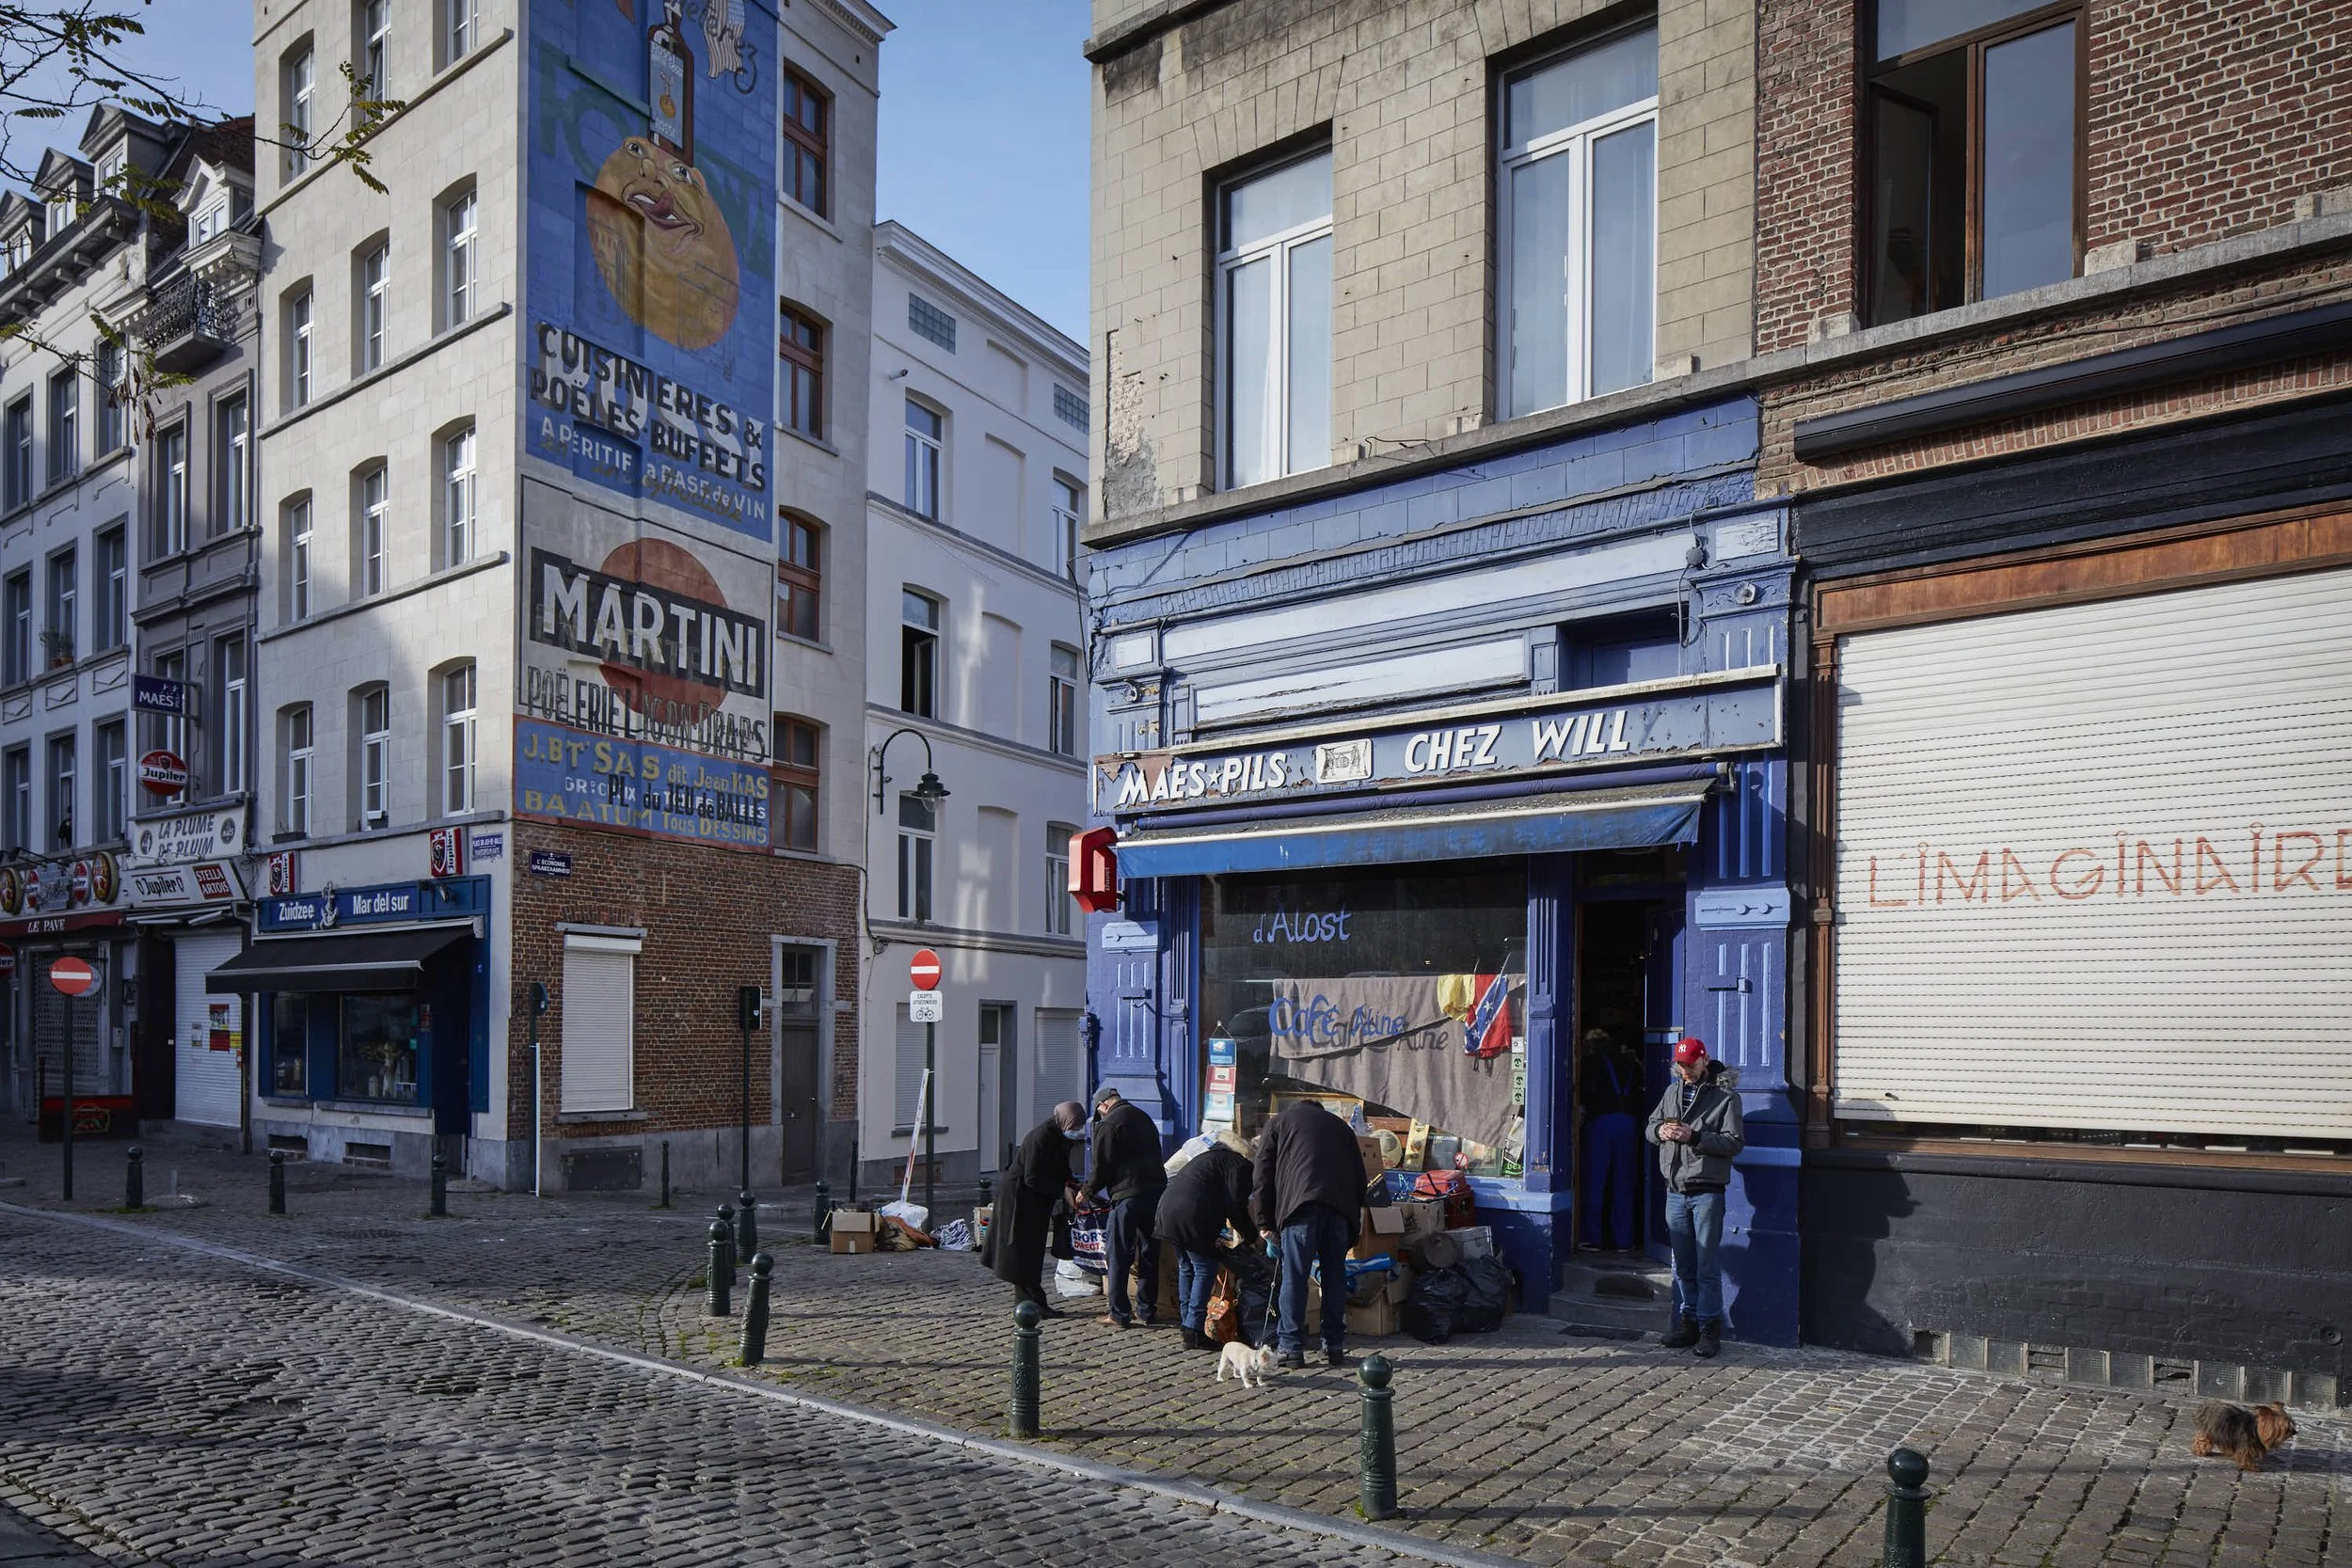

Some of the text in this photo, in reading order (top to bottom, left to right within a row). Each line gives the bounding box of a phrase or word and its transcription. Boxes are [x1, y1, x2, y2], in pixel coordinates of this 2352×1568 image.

[650, 420, 766, 491] BUFFETS
[543, 562, 757, 688] MARTINI
[1404, 710, 1629, 773] CHEZ WILL
[143, 766, 186, 782] Jupiler
[732, 772, 769, 800] KAS
[1116, 752, 1287, 805] MAES PILS
[158, 815, 215, 840] LA PLUME
[700, 817, 767, 845] DESSINS
[176, 837, 214, 857] PLUIM
[446, 832, 454, 871] Jupiler
[196, 869, 224, 880] STELLA
[202, 880, 230, 894] ARTOIS
[278, 901, 314, 922] Zuidzee
[353, 895, 409, 914] Mar del sur
[1268, 993, 1341, 1049] Café
